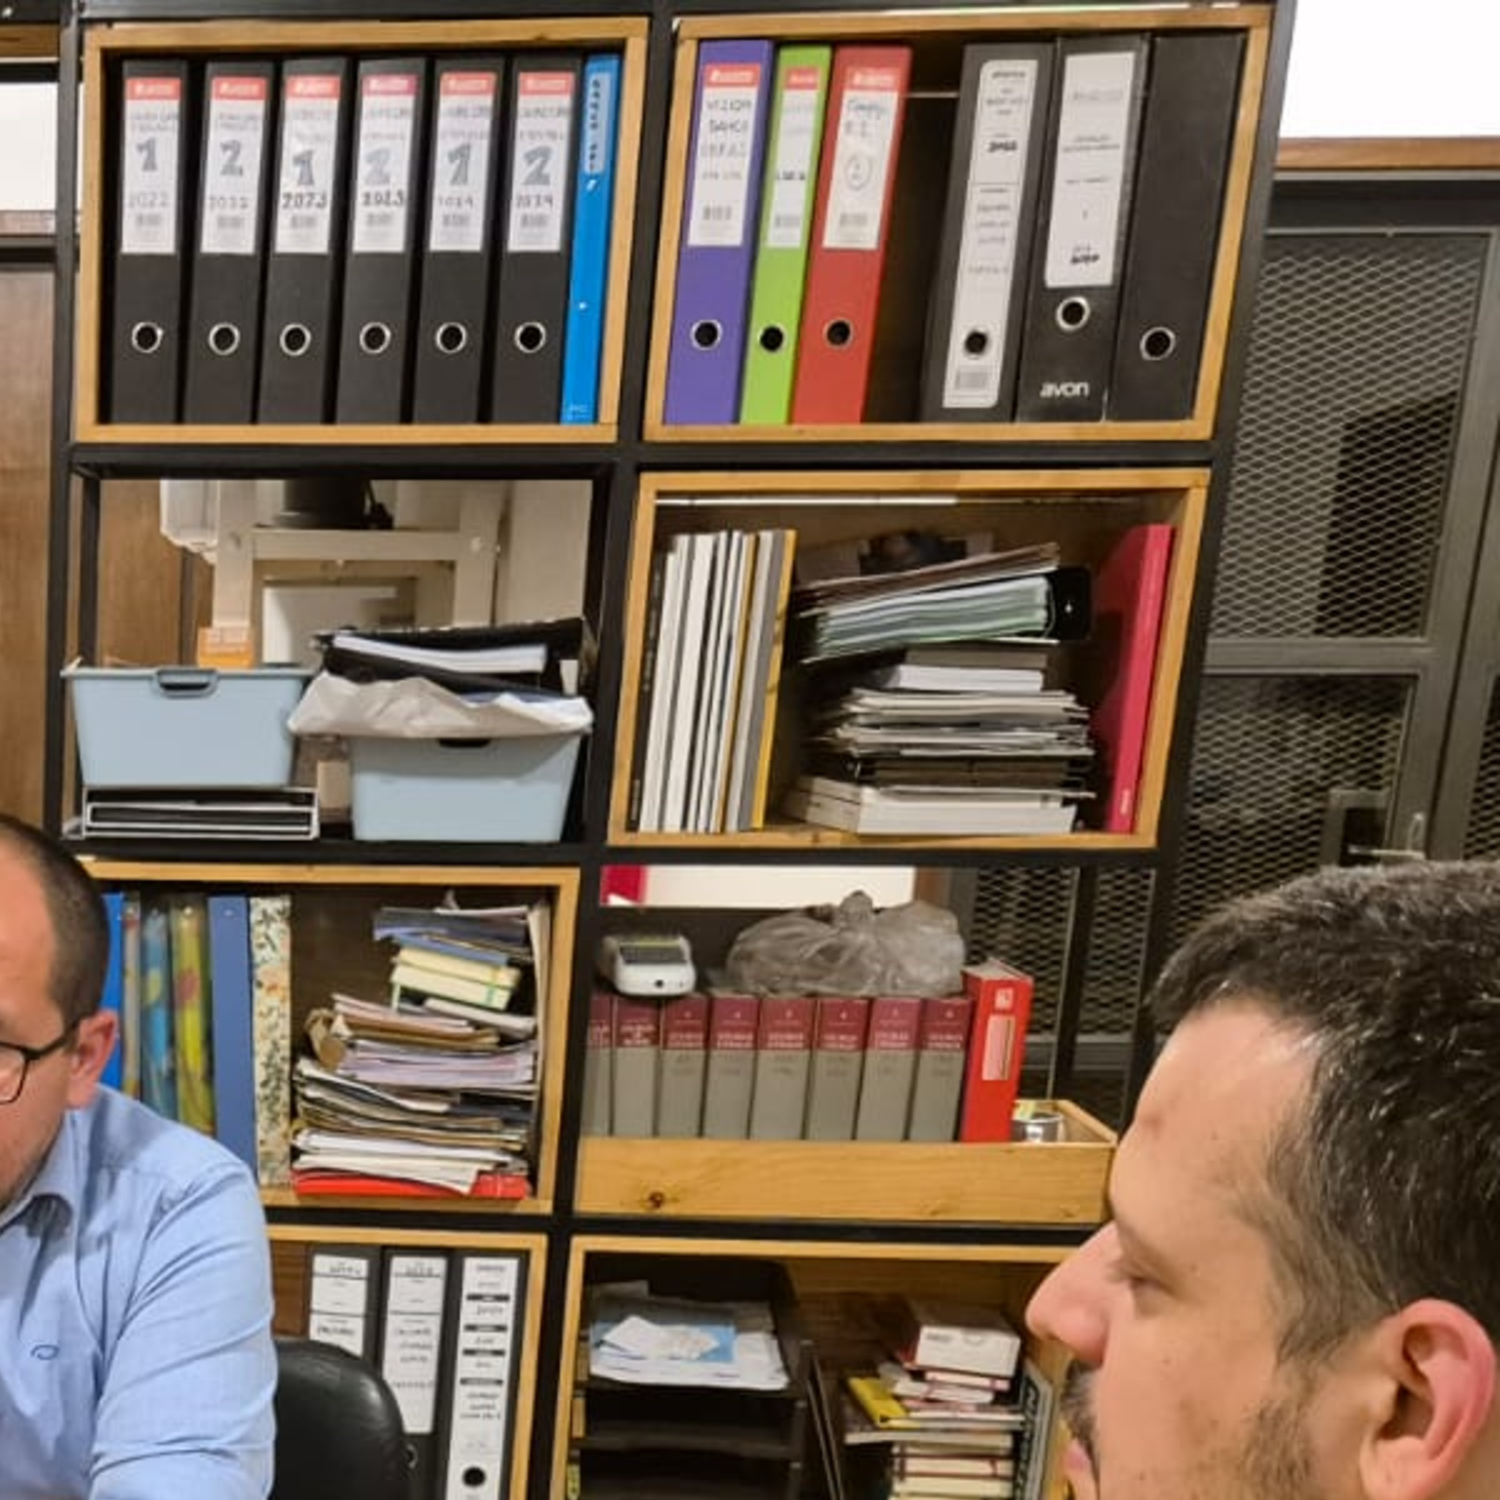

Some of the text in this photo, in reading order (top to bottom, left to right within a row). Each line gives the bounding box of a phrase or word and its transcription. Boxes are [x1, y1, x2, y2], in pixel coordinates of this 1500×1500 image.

[136, 137, 158, 172] 1
[219, 139, 244, 177] 2
[292, 149, 315, 187] 1
[364, 146, 392, 186] 2
[446, 142, 472, 186] 1
[522, 145, 552, 187] 2
[1039, 381, 1090, 398] avon
